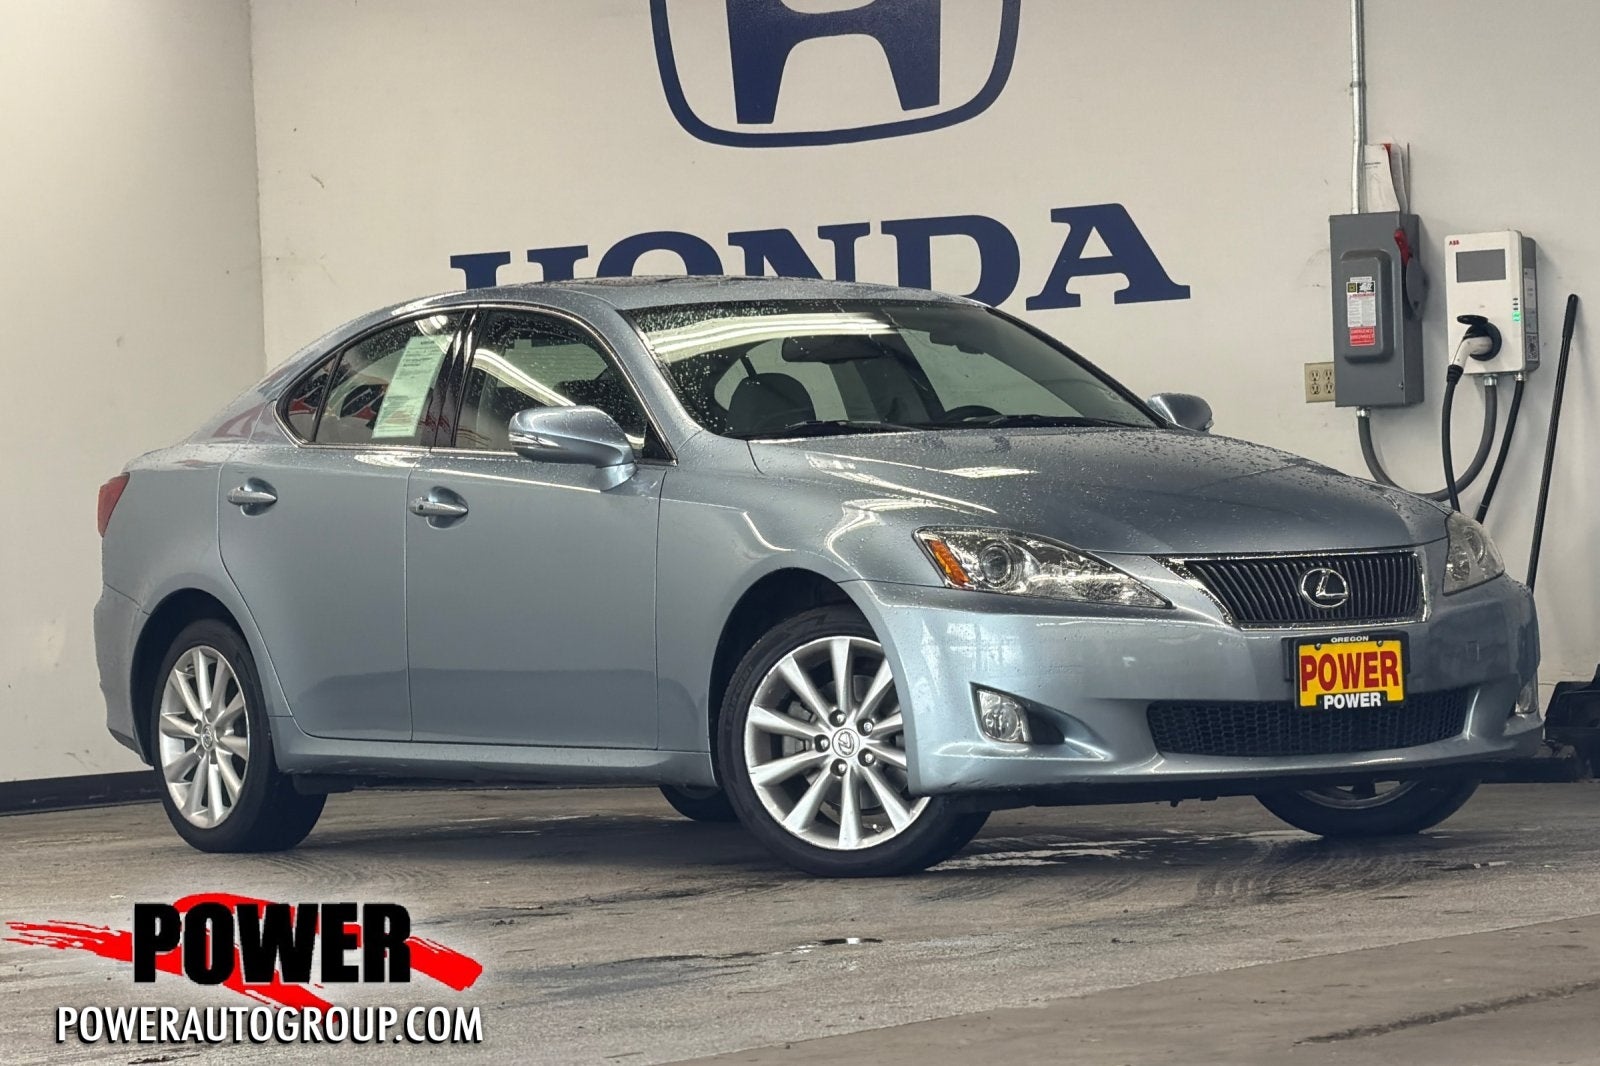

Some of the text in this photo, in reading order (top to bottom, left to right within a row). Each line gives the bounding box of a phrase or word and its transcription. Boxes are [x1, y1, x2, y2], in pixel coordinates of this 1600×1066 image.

[1330, 635, 1369, 643] OREGON
[1300, 650, 1400, 692] POWER
[1323, 692, 1381, 710] POWER
